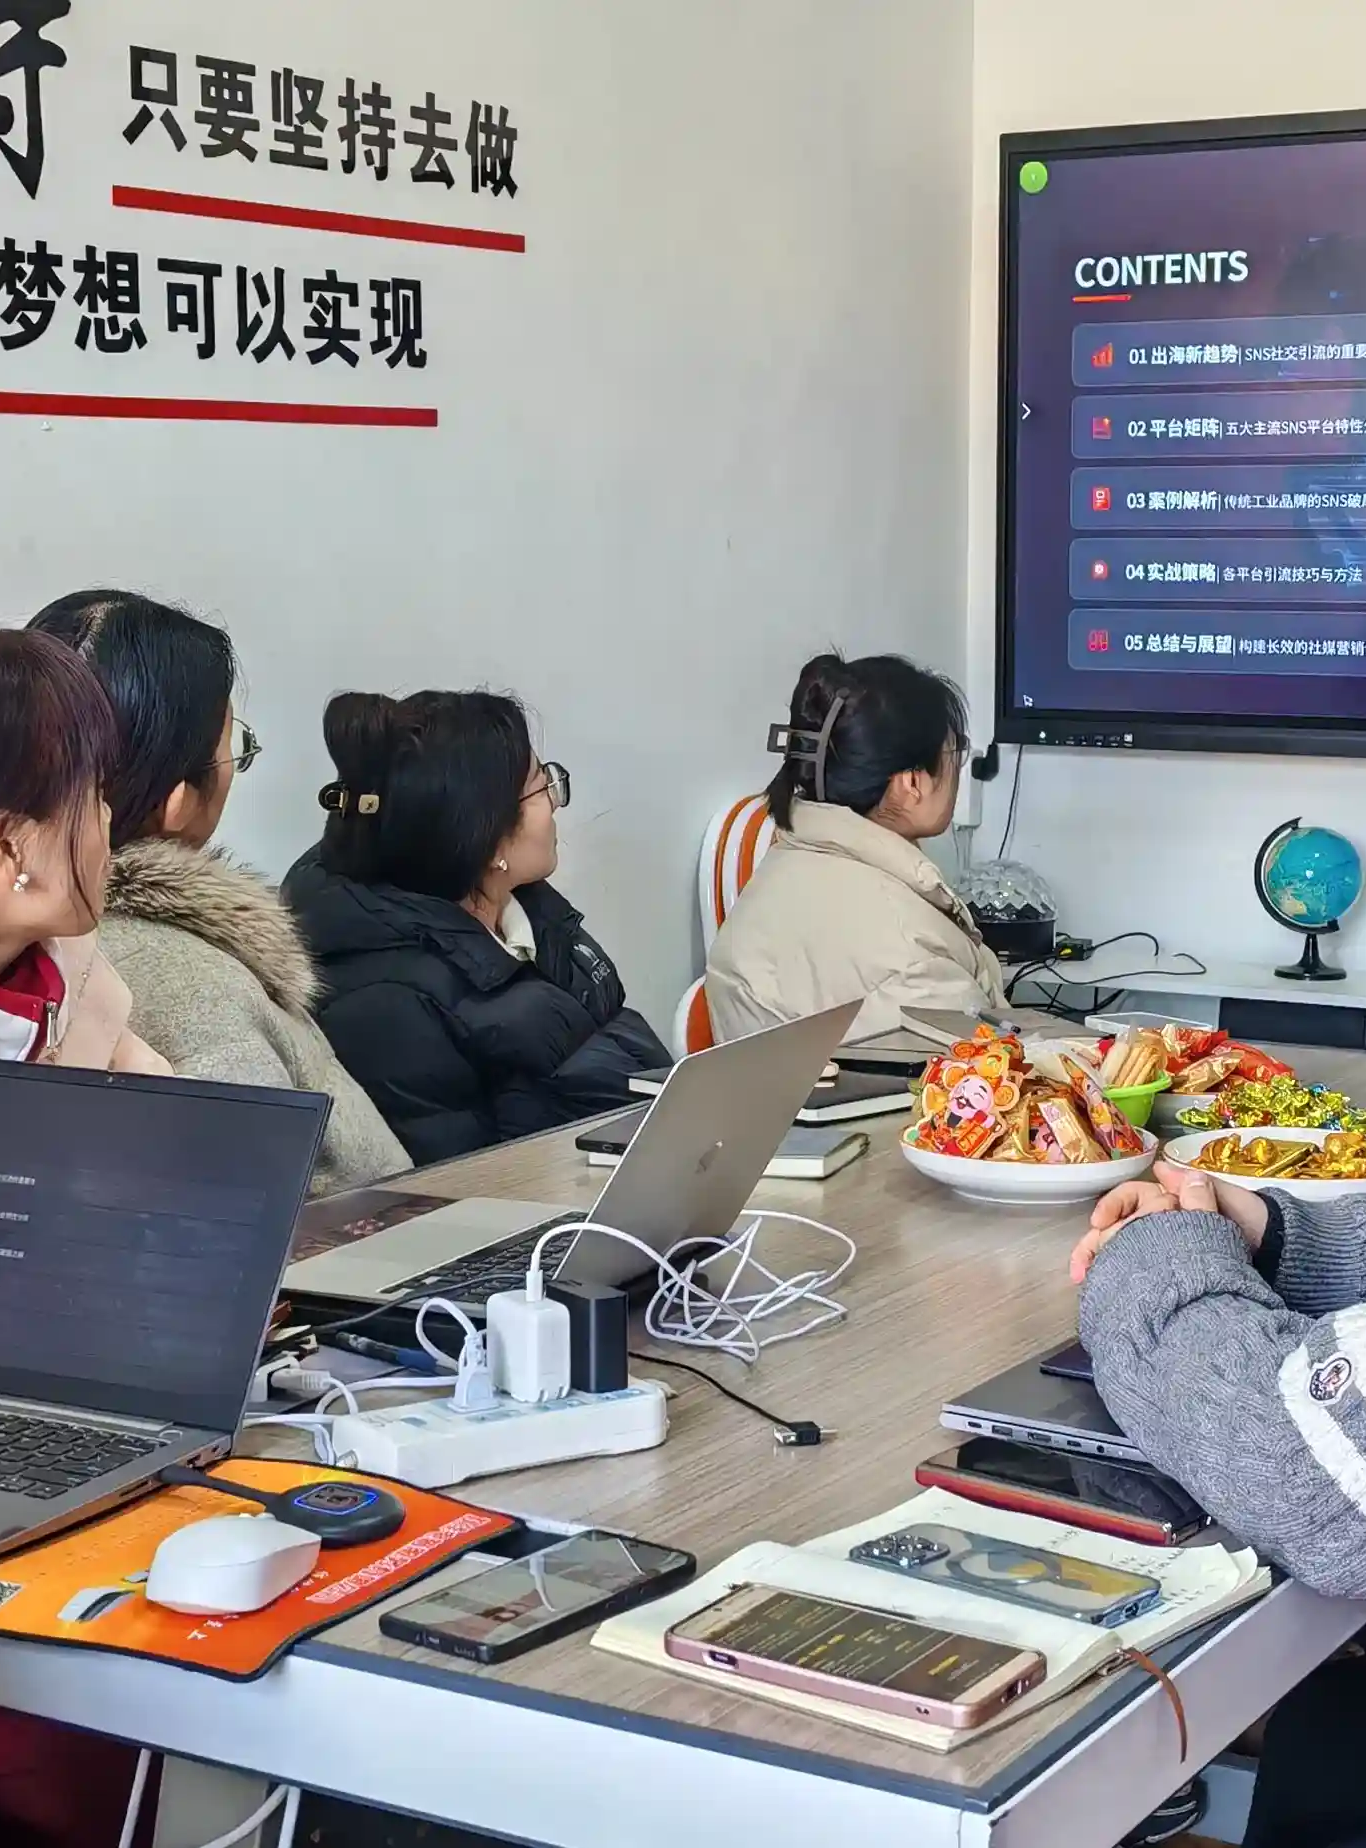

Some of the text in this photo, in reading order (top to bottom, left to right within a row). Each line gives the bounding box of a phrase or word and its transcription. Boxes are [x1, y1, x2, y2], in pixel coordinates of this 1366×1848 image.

[123, 46, 518, 199] 只要坚持去做
[1075, 250, 1248, 288] CONTENTS
[1129, 348, 1147, 364] 01
[1128, 421, 1147, 437] 02
[1127, 493, 1145, 509] 03
[1126, 564, 1145, 580] 04
[1125, 635, 1143, 651] 05
